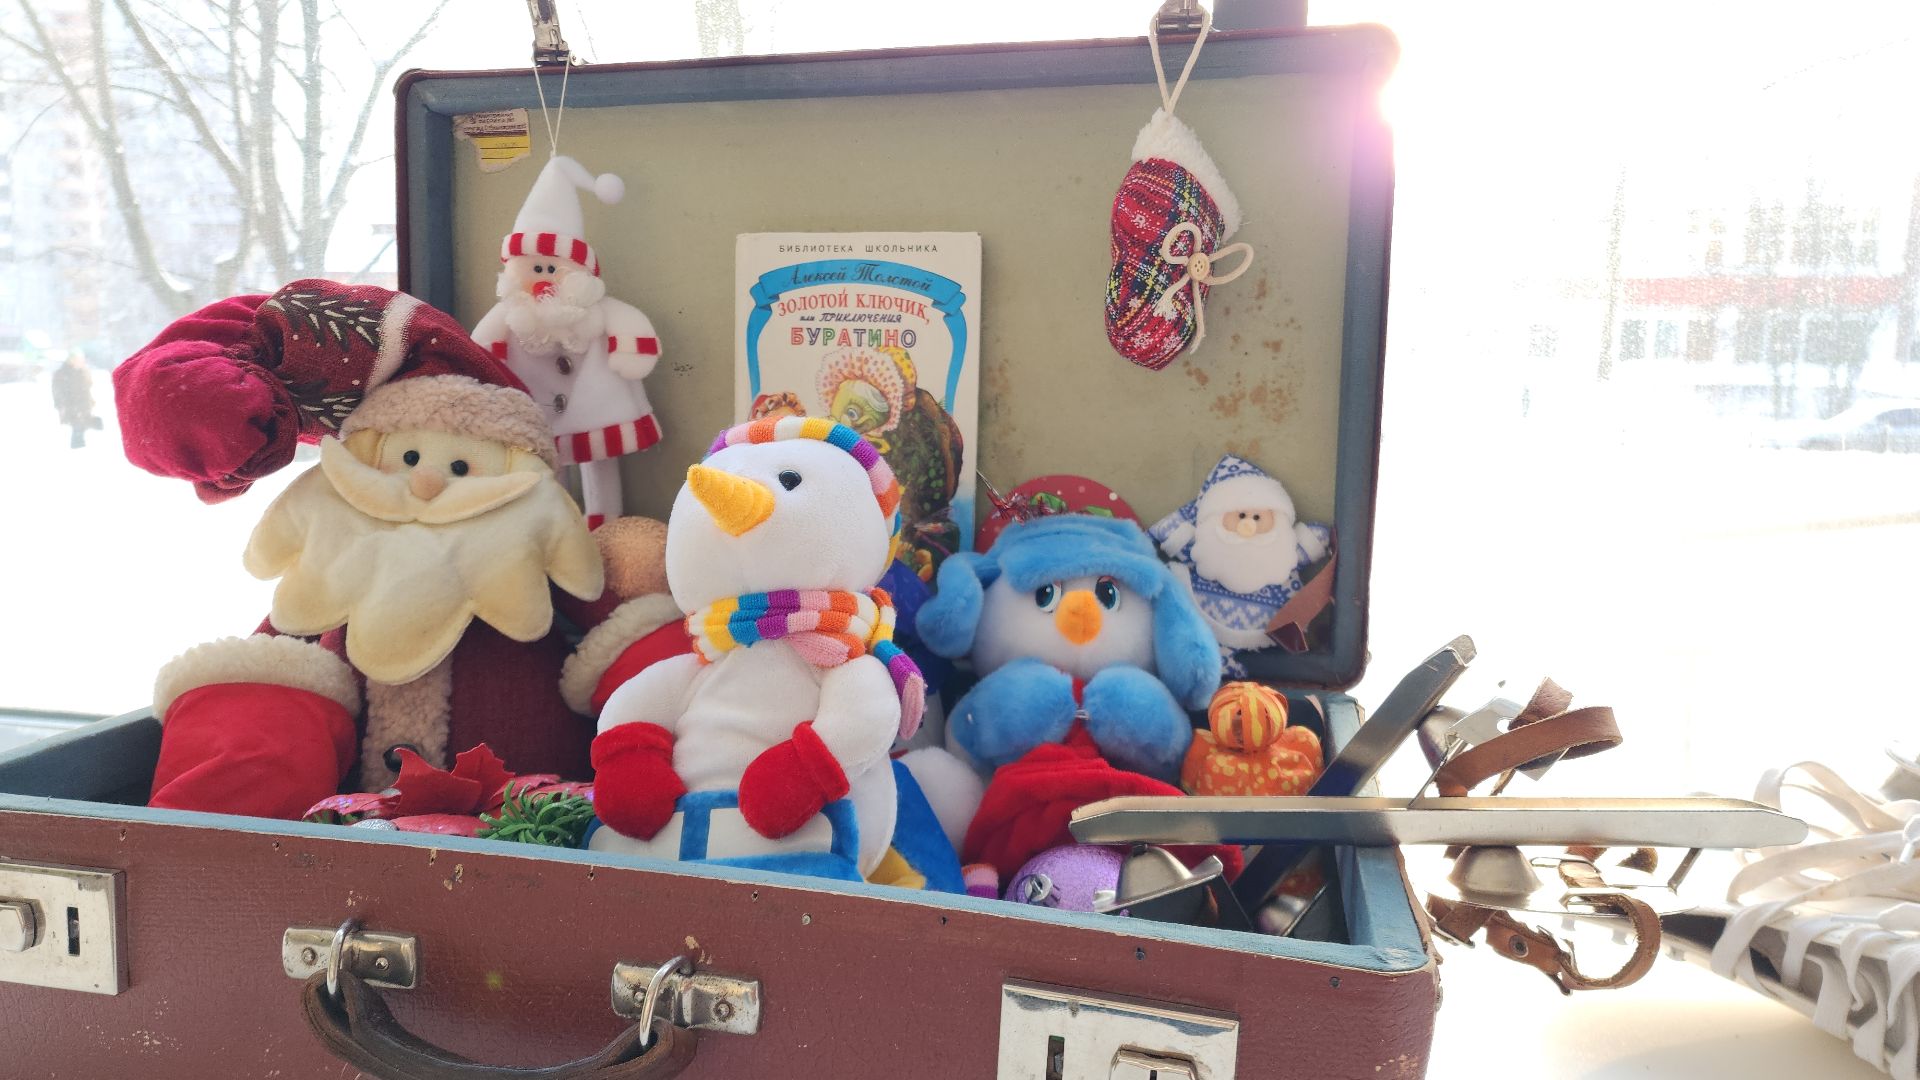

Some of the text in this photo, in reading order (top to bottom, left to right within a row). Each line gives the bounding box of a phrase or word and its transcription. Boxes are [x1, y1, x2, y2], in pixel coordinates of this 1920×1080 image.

[779, 245, 939, 253] БИБЛИОТЕКА ШКОЛЬНИКА
[784, 263, 932, 291] Алексей Толстой
[778, 288, 930, 324] ЗОЛОТОЙ КЛЮЧИК,
[791, 327, 917, 348] БУРАТИНО
